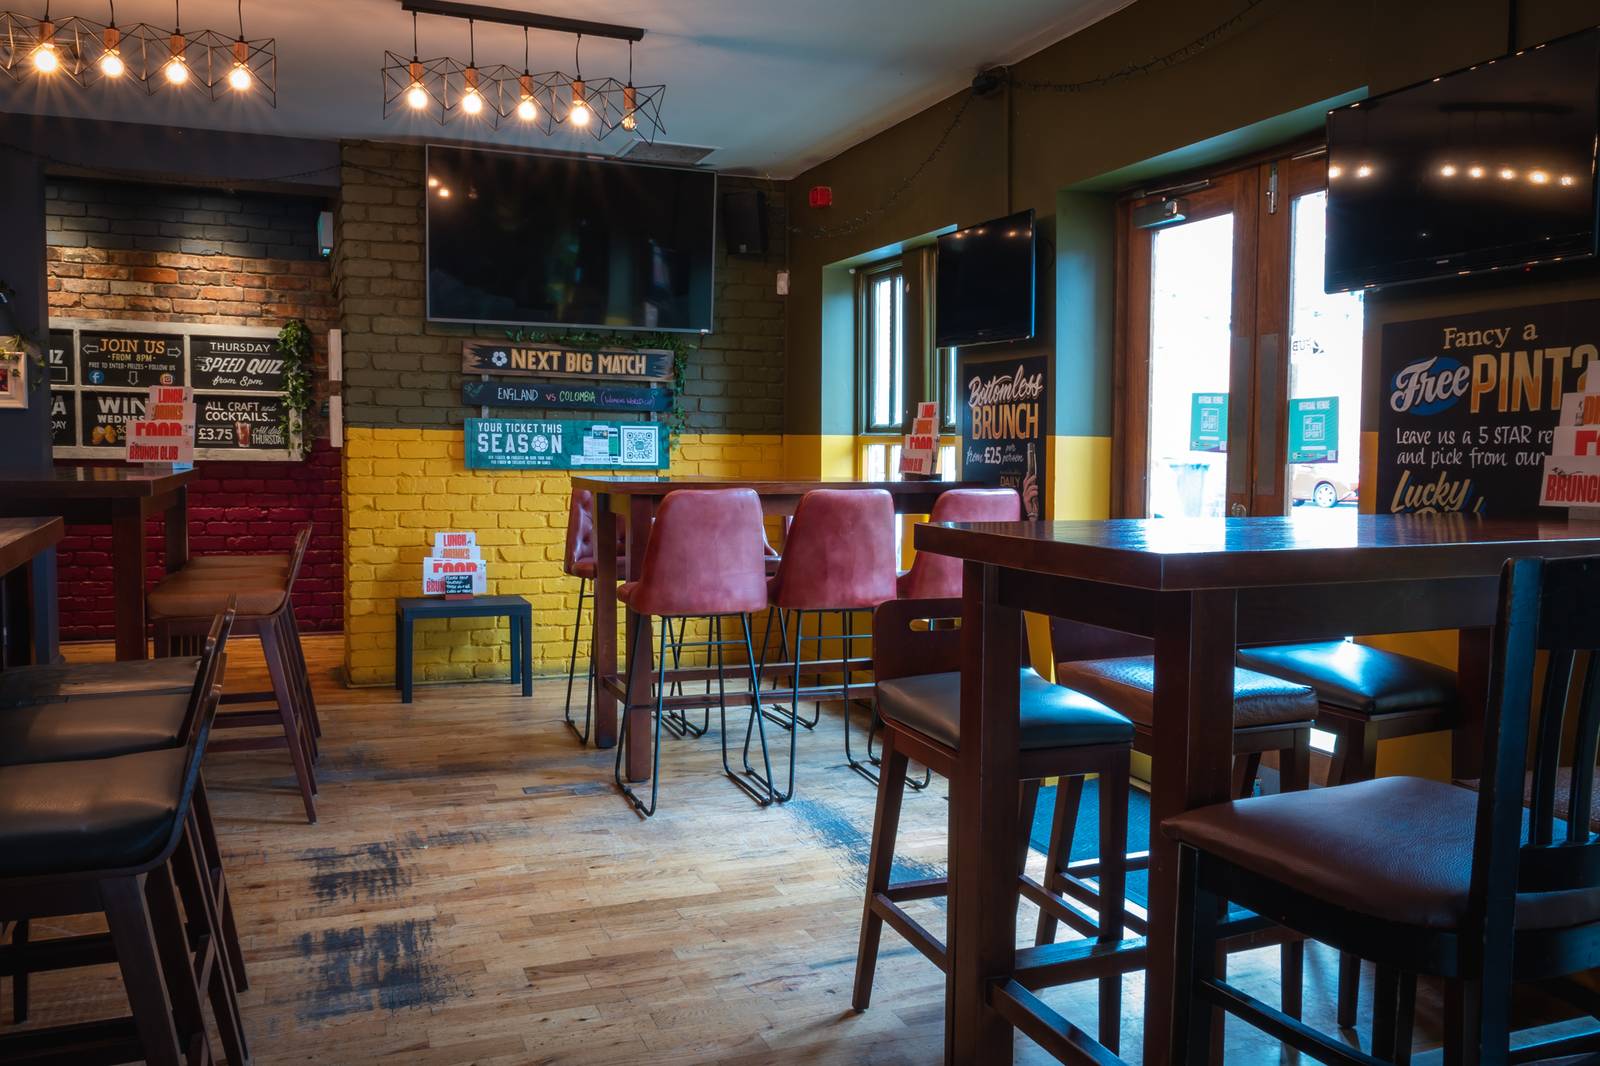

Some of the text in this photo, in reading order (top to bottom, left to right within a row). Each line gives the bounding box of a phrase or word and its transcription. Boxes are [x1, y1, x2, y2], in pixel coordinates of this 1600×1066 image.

[1443, 323, 1539, 349] Fancy a
[100, 339, 165, 355] JOIN US
[210, 342, 271, 353] THURSDAY
[201, 356, 284, 375] SPEED QUIZ
[511, 348, 647, 377] NEXT BIG MATCH
[212, 375, 237, 386] from
[968, 364, 1043, 408] Bottomless
[1390, 344, 1598, 414] Free PINT?
[497, 387, 539, 402] ENGLAND
[559, 390, 596, 404] COLOMBIA
[205, 402, 224, 411] ALL
[228, 402, 259, 412] CRAFT
[205, 411, 276, 422] COCKTAILS...
[972, 403, 1039, 440] BRUNCH
[198, 428, 233, 441] £3.75
[478, 422, 562, 434] YOUR TICKET THIS
[1396, 427, 1432, 445] Leave
[1438, 430, 1456, 444] us
[1462, 430, 1472, 444] a
[1478, 426, 1488, 443] 5
[1493, 425, 1532, 444] STAR
[984, 446, 1001, 464] £25
[1397, 448, 1545, 469] and pick from our
[1391, 470, 1471, 513] Lucky
[1545, 474, 1600, 503] BRUNC
[444, 534, 467, 547] LUNCH
